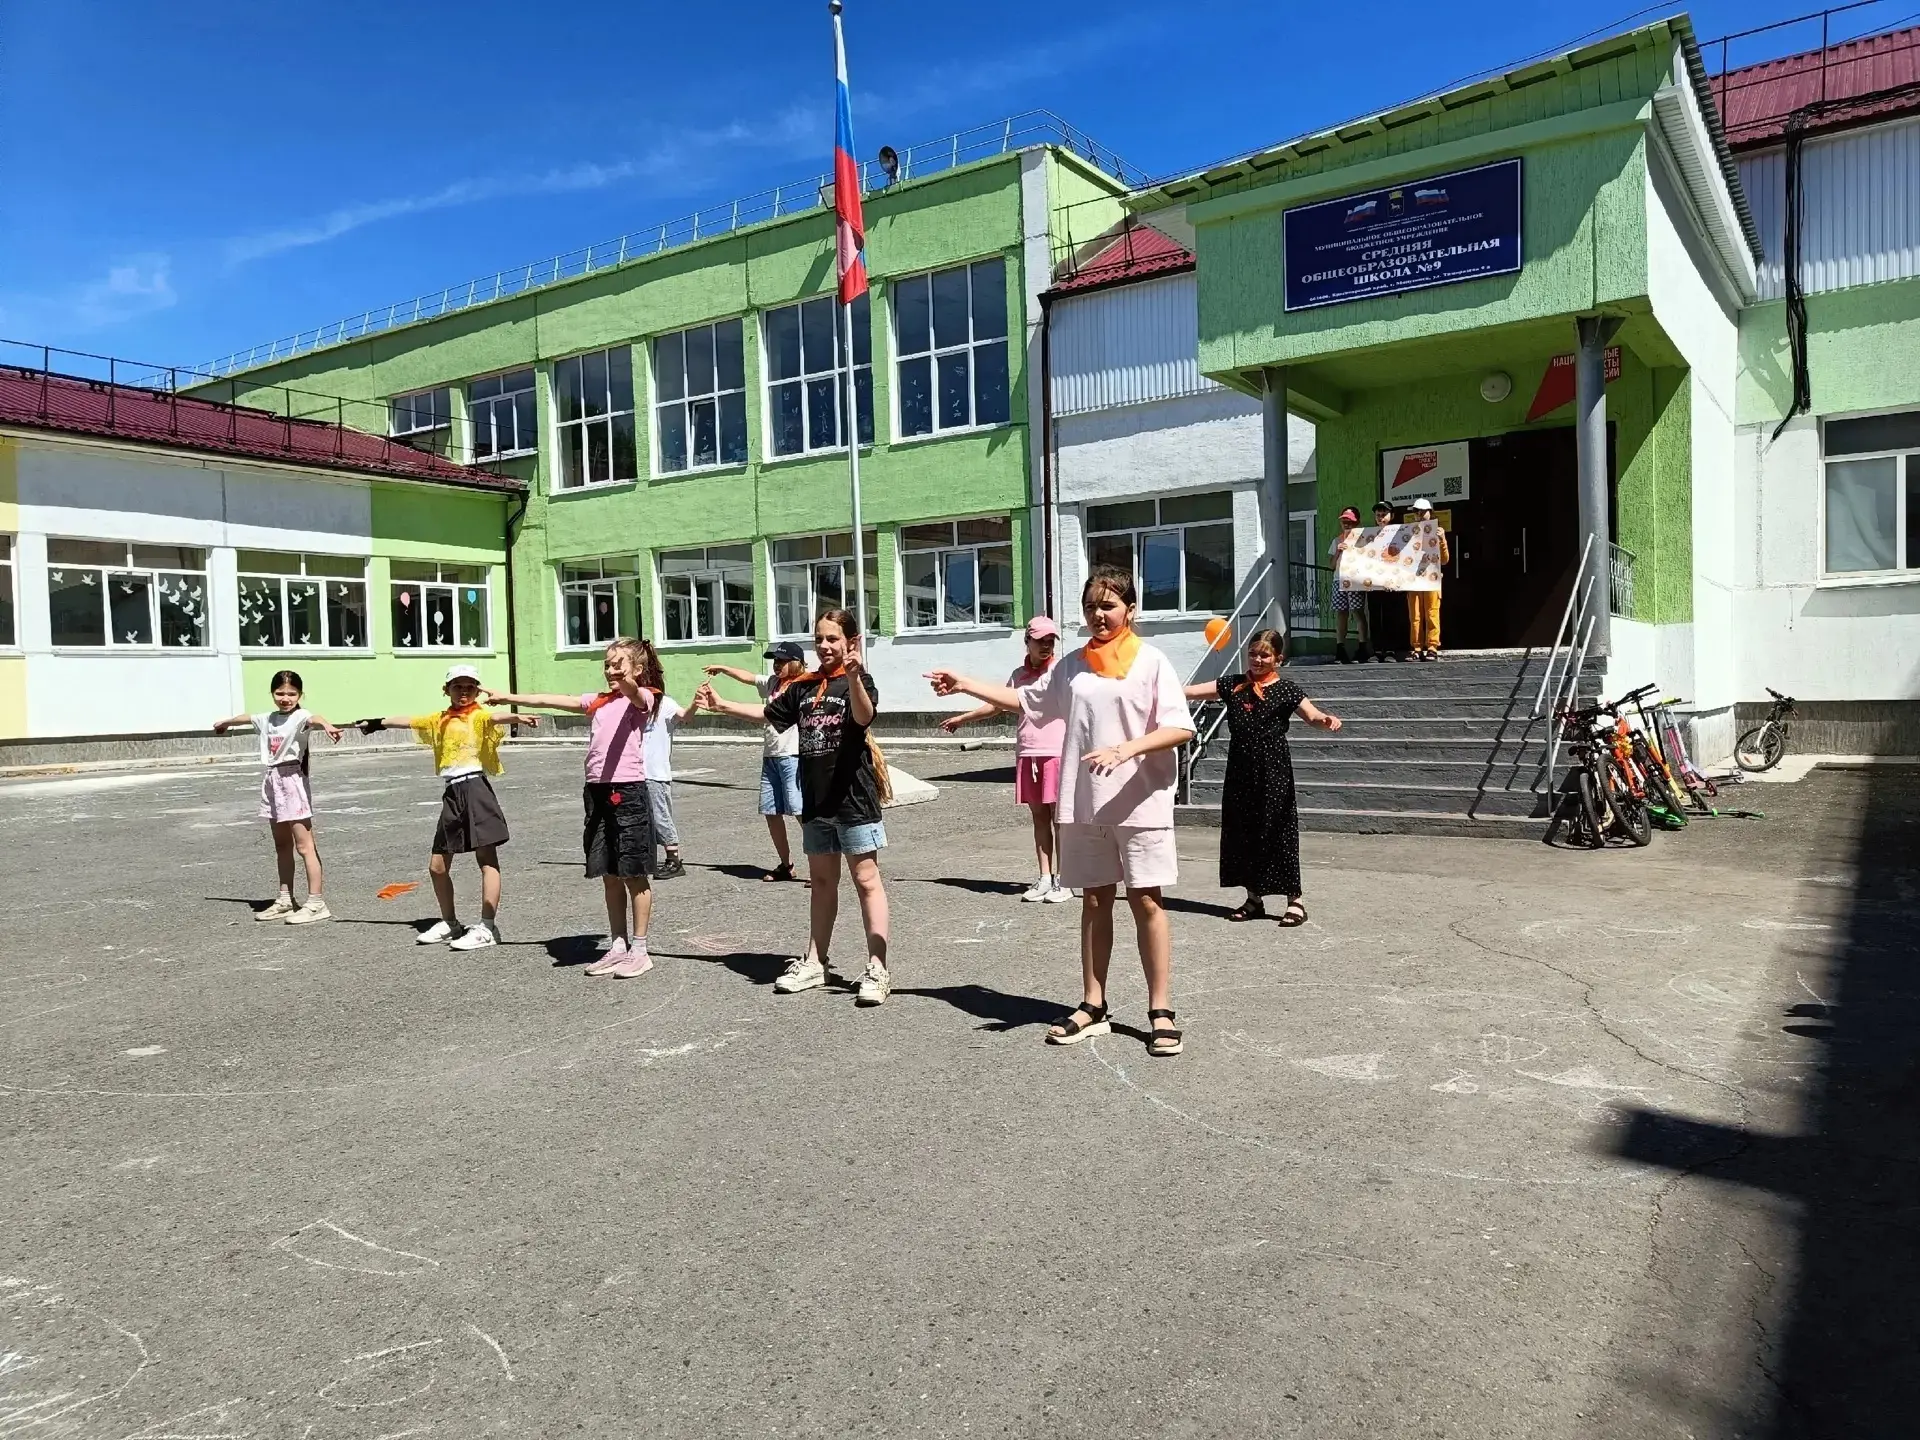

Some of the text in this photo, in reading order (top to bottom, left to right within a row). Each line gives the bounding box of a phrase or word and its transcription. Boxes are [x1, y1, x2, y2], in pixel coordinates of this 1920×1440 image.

[1396, 226, 1449, 243] УЧРЕЖДЕНИЕ
[1301, 238, 1500, 284] ОБЩЕОБРАЗОВАТЕЛЬНАЯ
[1361, 239, 1433, 261] СРЕДНЯЯ
[1353, 260, 1442, 285] ШКОЛА №9
